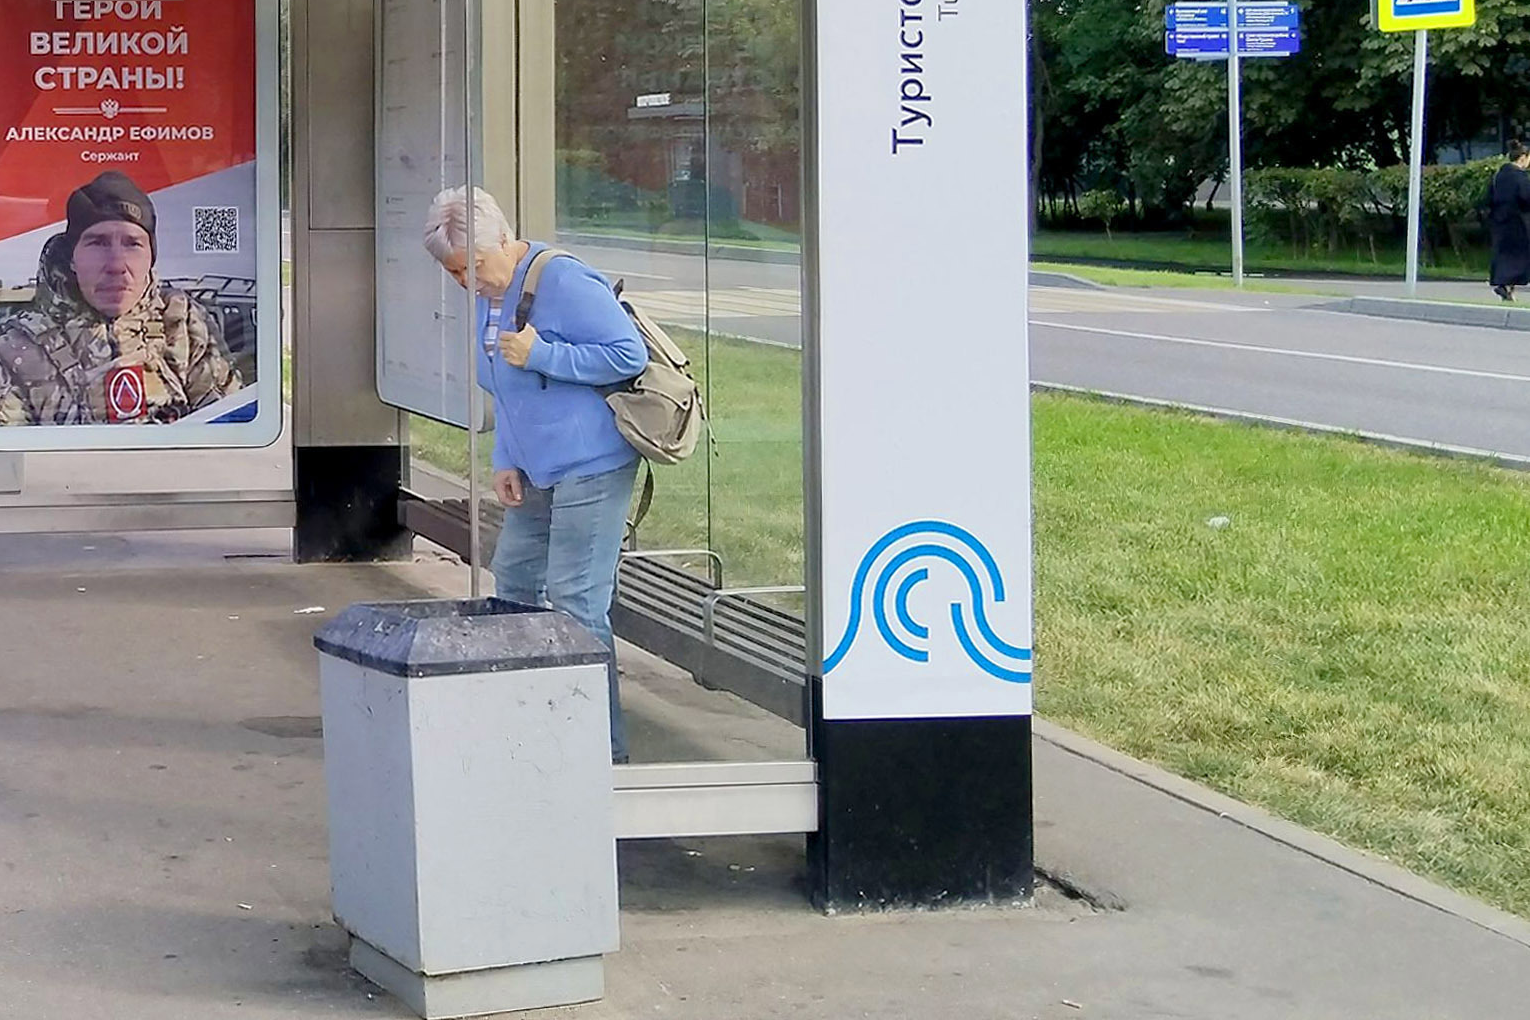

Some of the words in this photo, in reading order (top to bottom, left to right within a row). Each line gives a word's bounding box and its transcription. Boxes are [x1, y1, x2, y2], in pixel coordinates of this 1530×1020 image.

[29, 25, 189, 55] ВЕЛИКОЙ
[34, 66, 185, 90] СТРАНЫ!
[5, 126, 124, 143] АЛЕКСАНДР
[129, 126, 214, 141] ЕФИМОВ
[80, 150, 140, 163] Сержант
